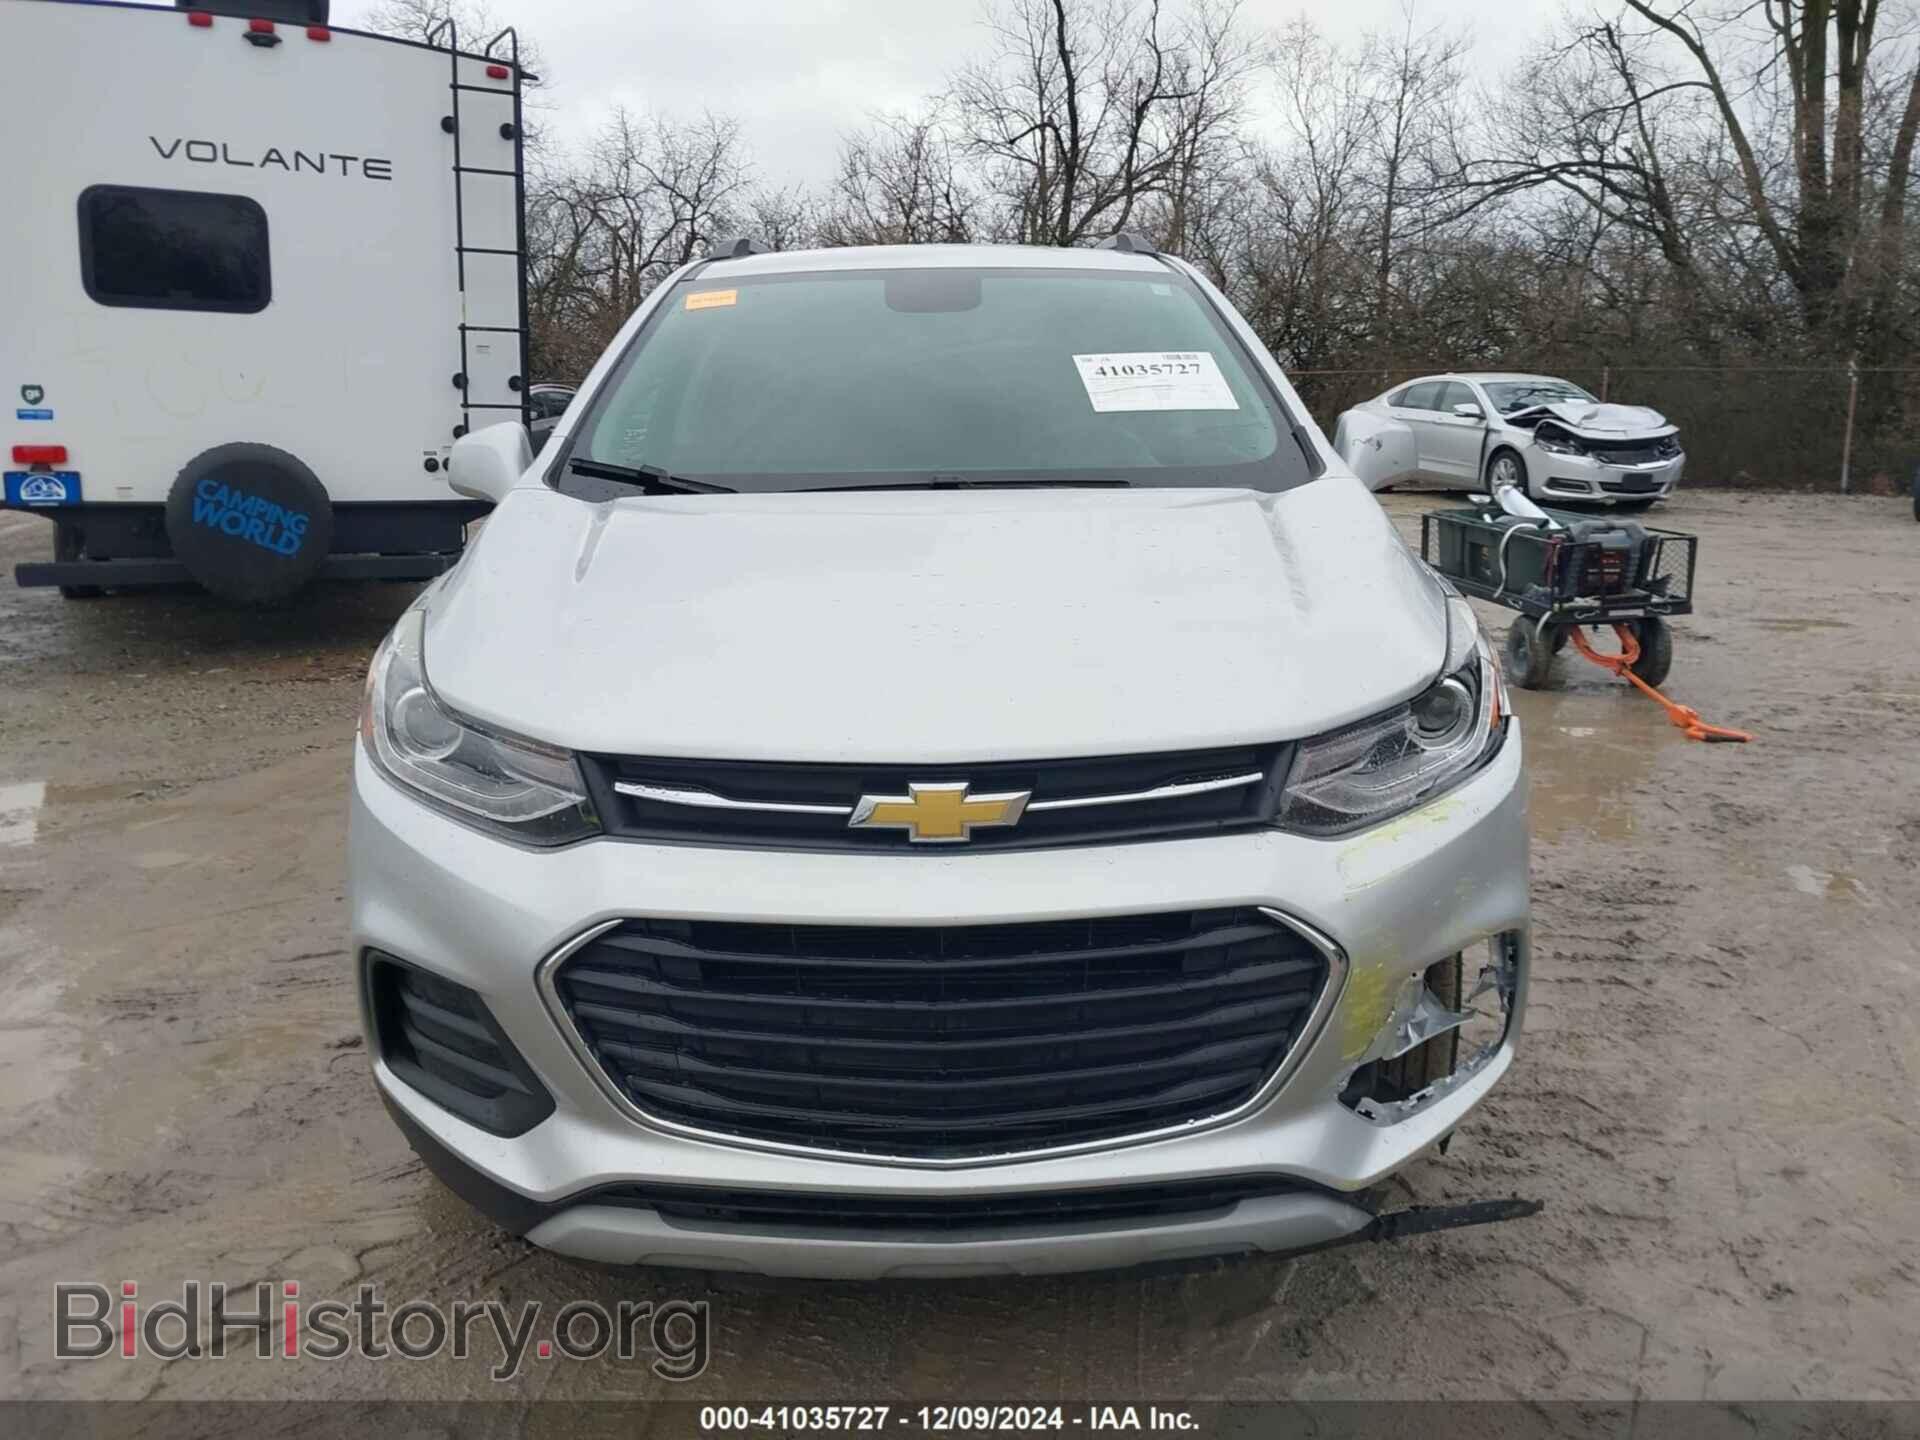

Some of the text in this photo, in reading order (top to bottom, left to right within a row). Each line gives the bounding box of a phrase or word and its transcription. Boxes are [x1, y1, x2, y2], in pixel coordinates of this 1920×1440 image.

[149, 136, 392, 180] VOLANTE
[1095, 363, 1201, 377] 41035727
[193, 496, 301, 555] WORLD
[196, 479, 309, 535] CAMPING
